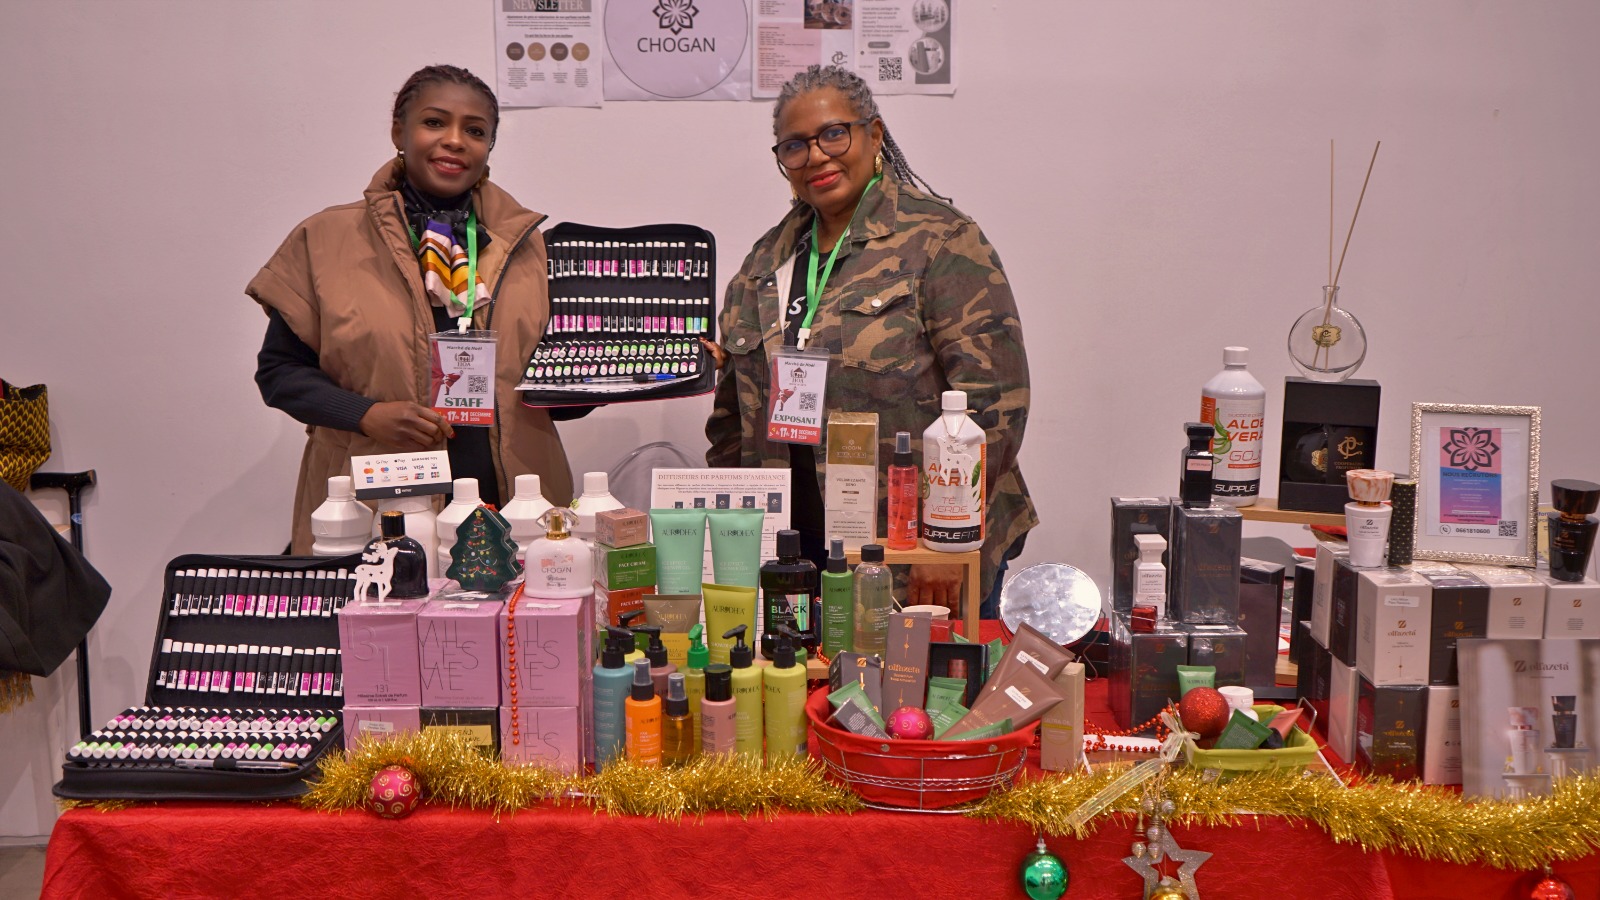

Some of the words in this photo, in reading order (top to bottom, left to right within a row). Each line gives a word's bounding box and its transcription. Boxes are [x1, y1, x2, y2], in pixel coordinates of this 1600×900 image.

[513, 0, 583, 10] NEWSLETTER
[637, 37, 715, 52] CHOGAN
[444, 397, 484, 407] STAFF
[448, 411, 456, 421] 17
[461, 412, 469, 421] 21
[774, 414, 817, 424] EXPOSANT
[780, 427, 786, 437] 17
[790, 428, 798, 438] 21
[932, 505, 968, 513] VERDE
[771, 605, 807, 614] BLACK
[1530, 662, 1569, 671] olfazeta
[375, 684, 389, 692] 131
